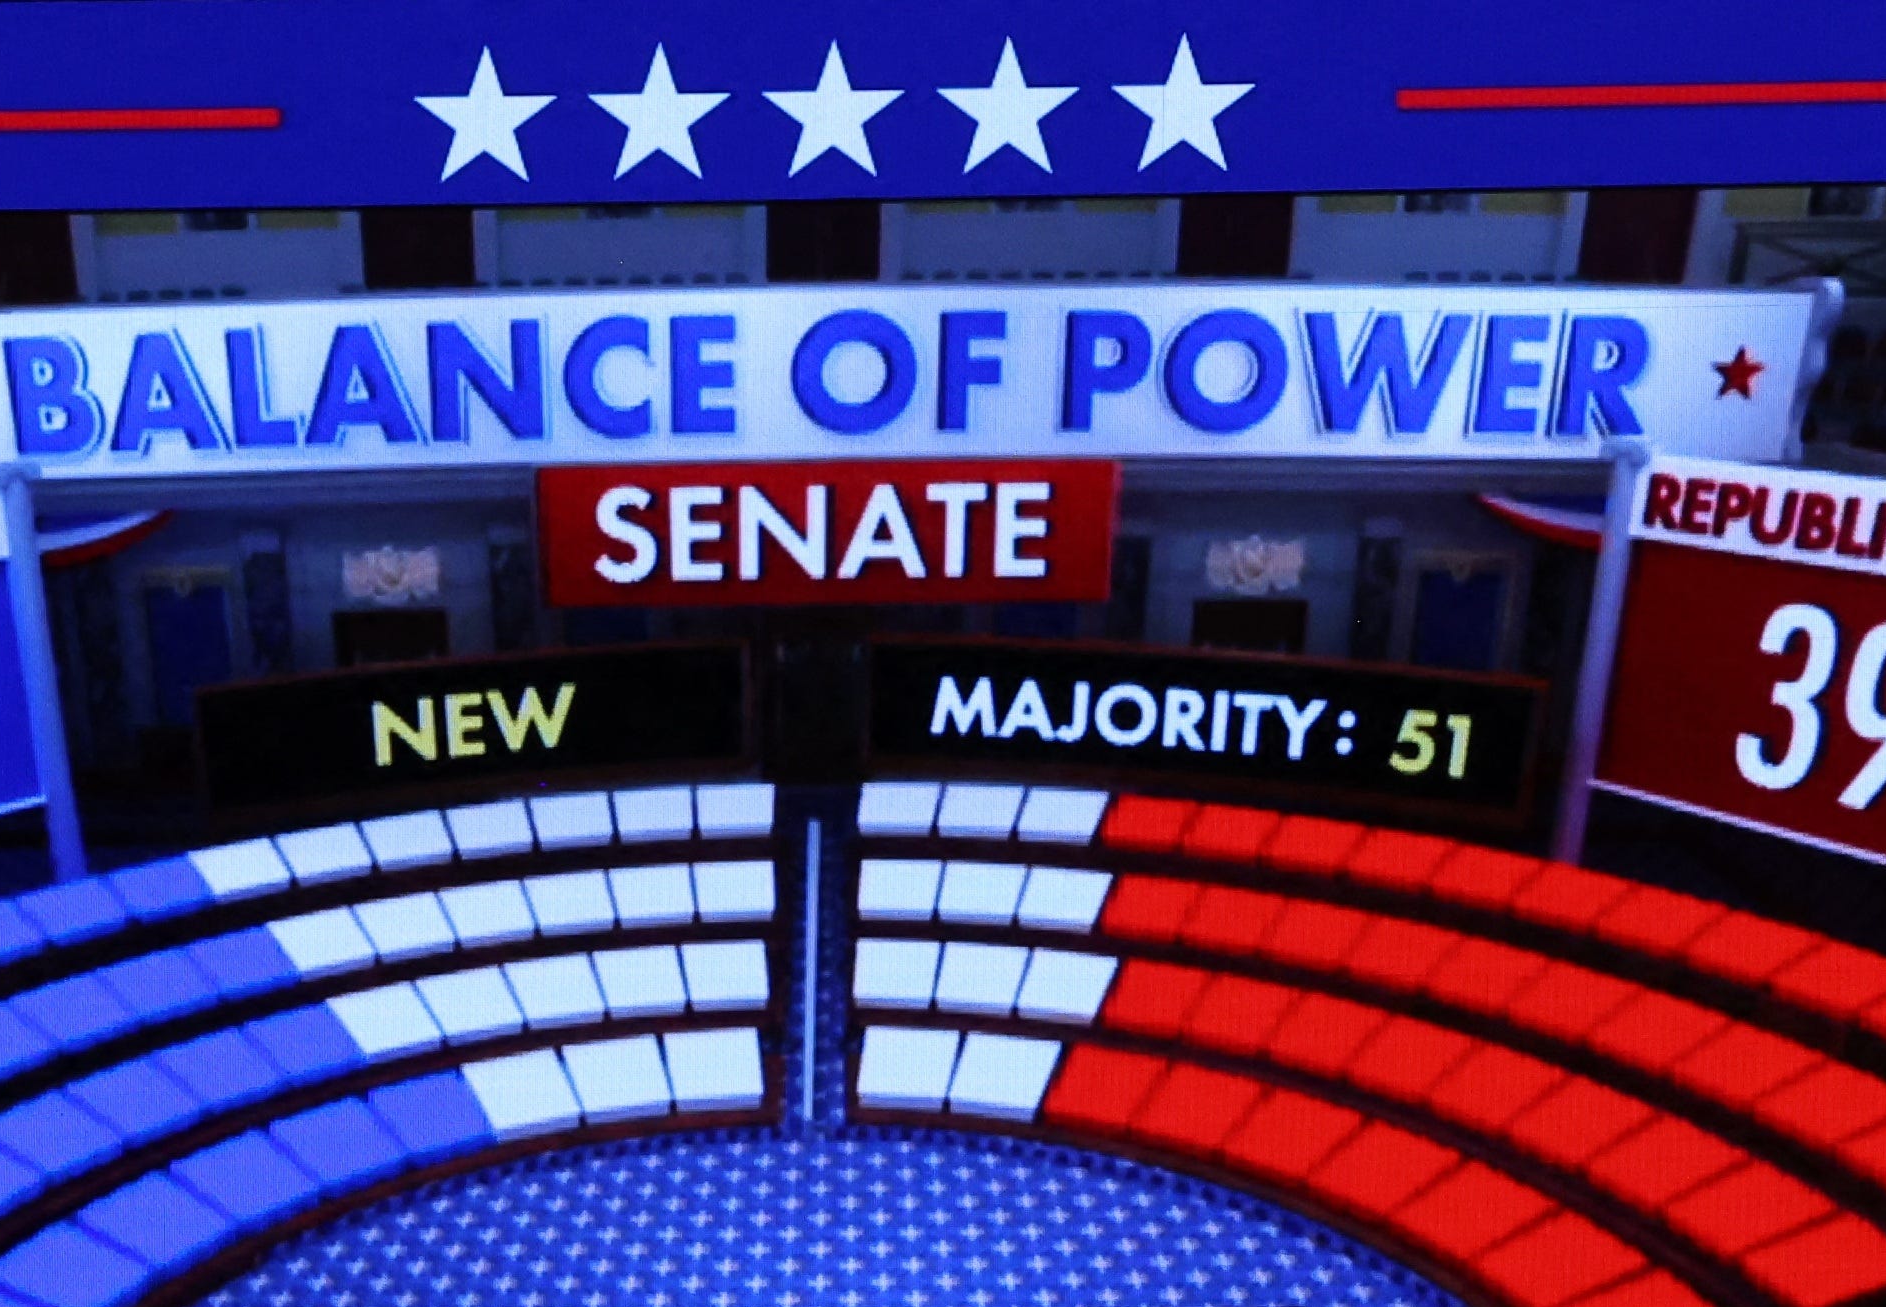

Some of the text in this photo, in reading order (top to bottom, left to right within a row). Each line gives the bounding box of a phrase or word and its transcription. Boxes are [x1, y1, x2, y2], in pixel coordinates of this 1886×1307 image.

[1, 308, 1651, 455] BALANCE OF POWER
[594, 482, 1048, 583] SENATE
[371, 683, 575, 766] NEW
[931, 676, 1470, 777] MAJORITY: 51
